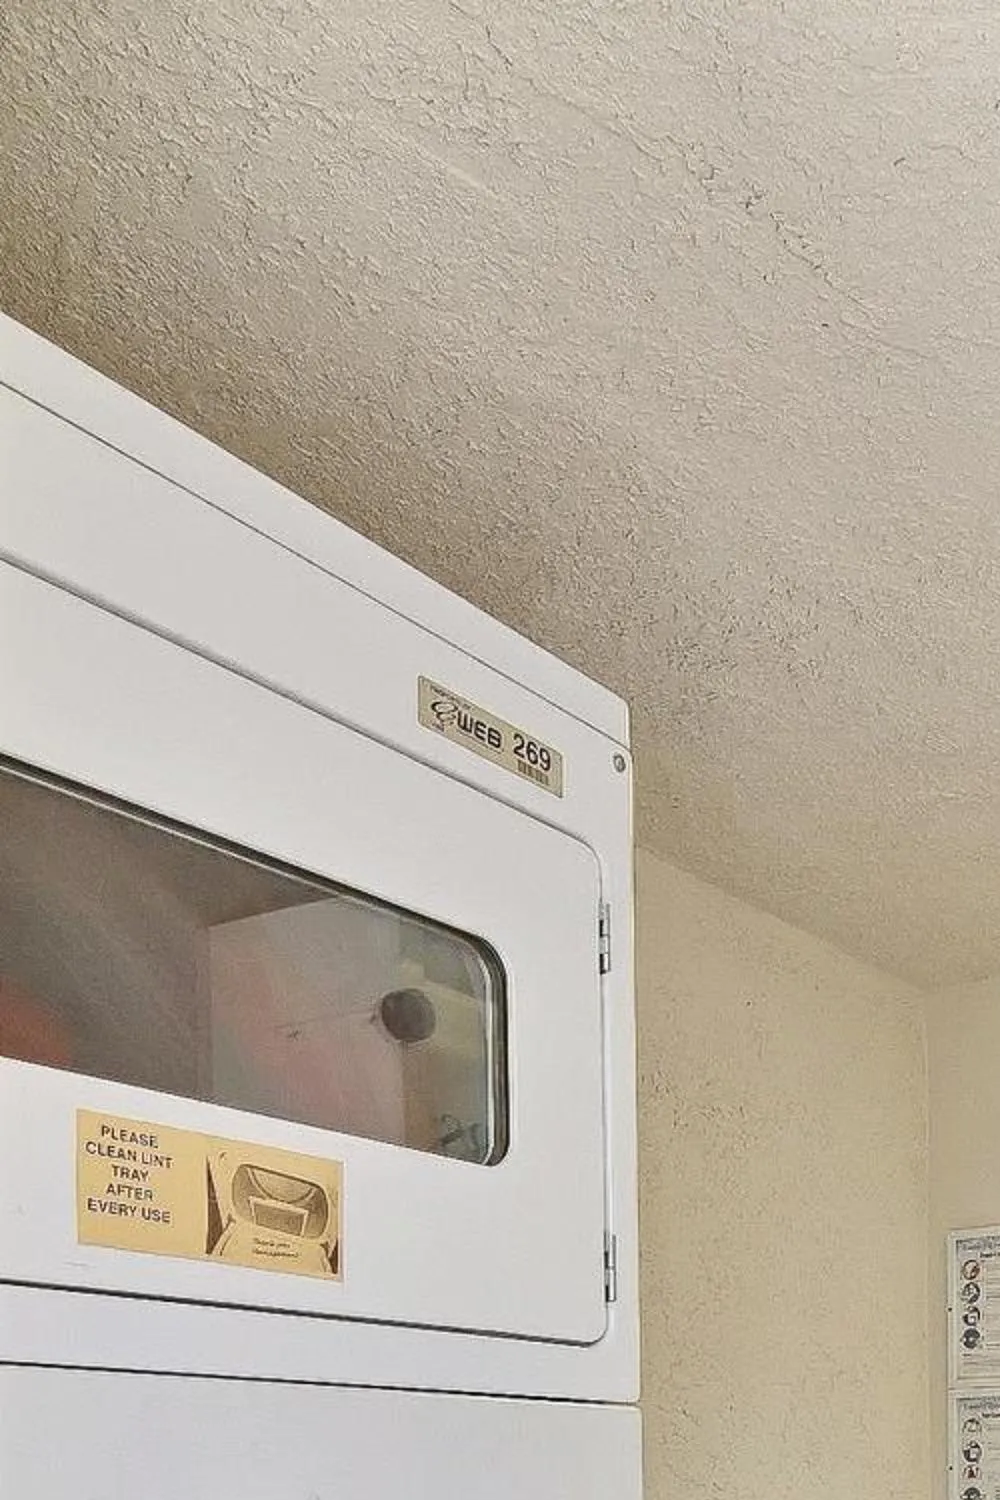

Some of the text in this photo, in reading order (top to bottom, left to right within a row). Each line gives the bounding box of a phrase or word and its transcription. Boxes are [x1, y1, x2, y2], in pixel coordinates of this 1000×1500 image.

[457, 712, 551, 772] WEB 269
[101, 1125, 158, 1149] PLEASE
[86, 1141, 173, 1169] CLEAN LINT
[111, 1164, 149, 1182] TRAY
[106, 1182, 153, 1201] AFTER
[87, 1197, 170, 1224] EVERY USE
